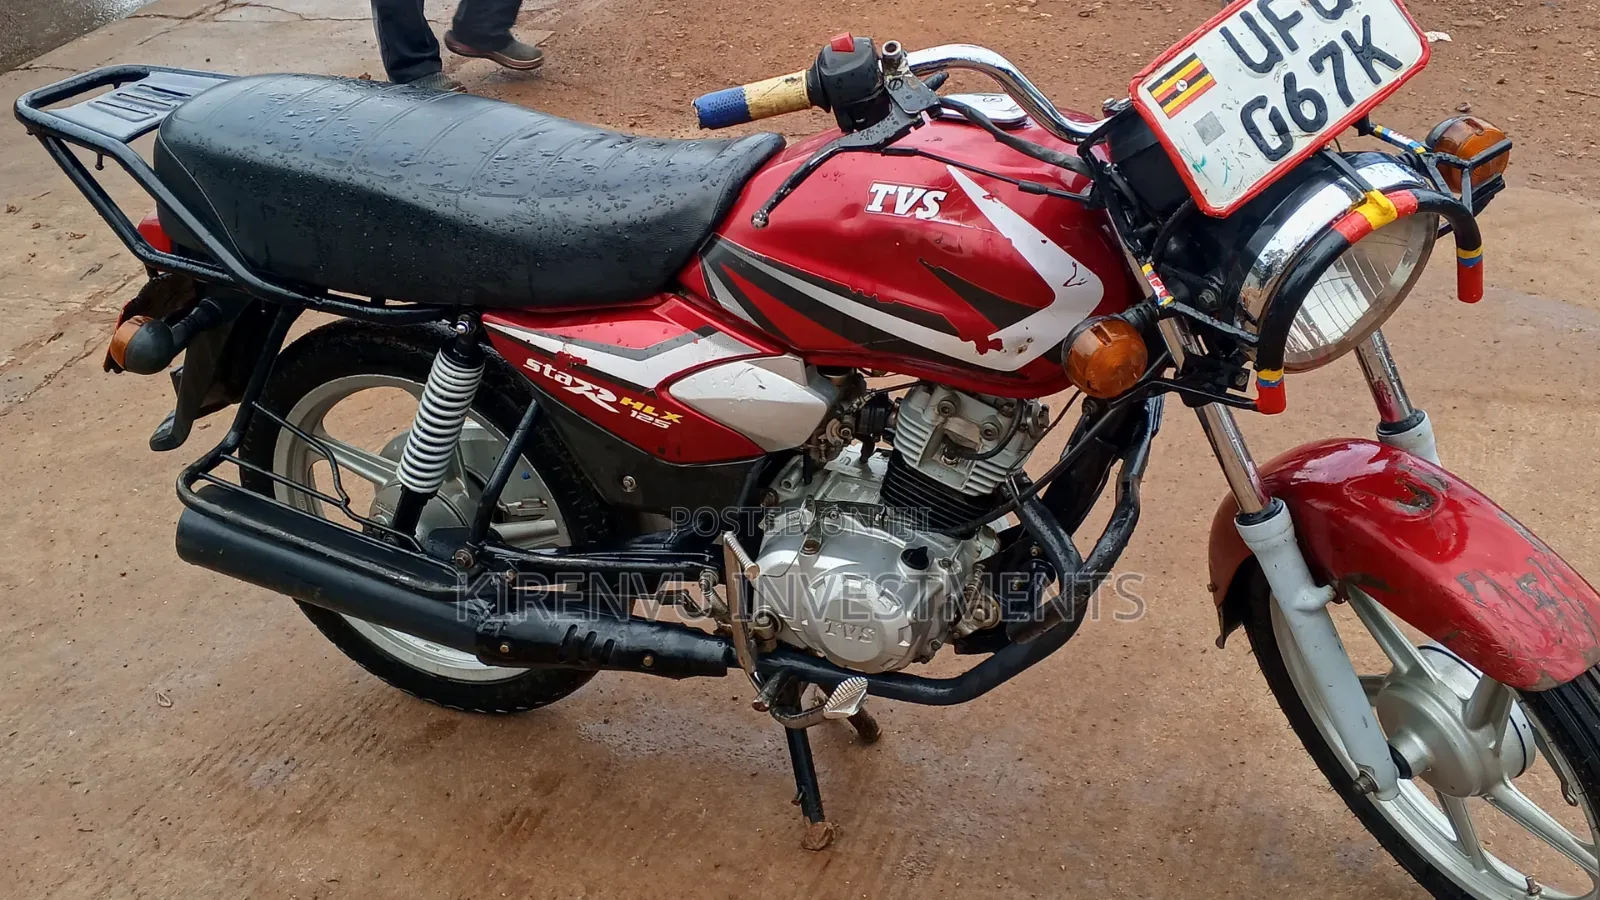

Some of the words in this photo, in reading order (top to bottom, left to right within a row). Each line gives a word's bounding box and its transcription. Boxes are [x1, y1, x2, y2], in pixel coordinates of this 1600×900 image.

[866, 182, 948, 219] TVS
[619, 397, 683, 424] HLX
[630, 410, 672, 430] 125
[825, 618, 876, 644] TVS
